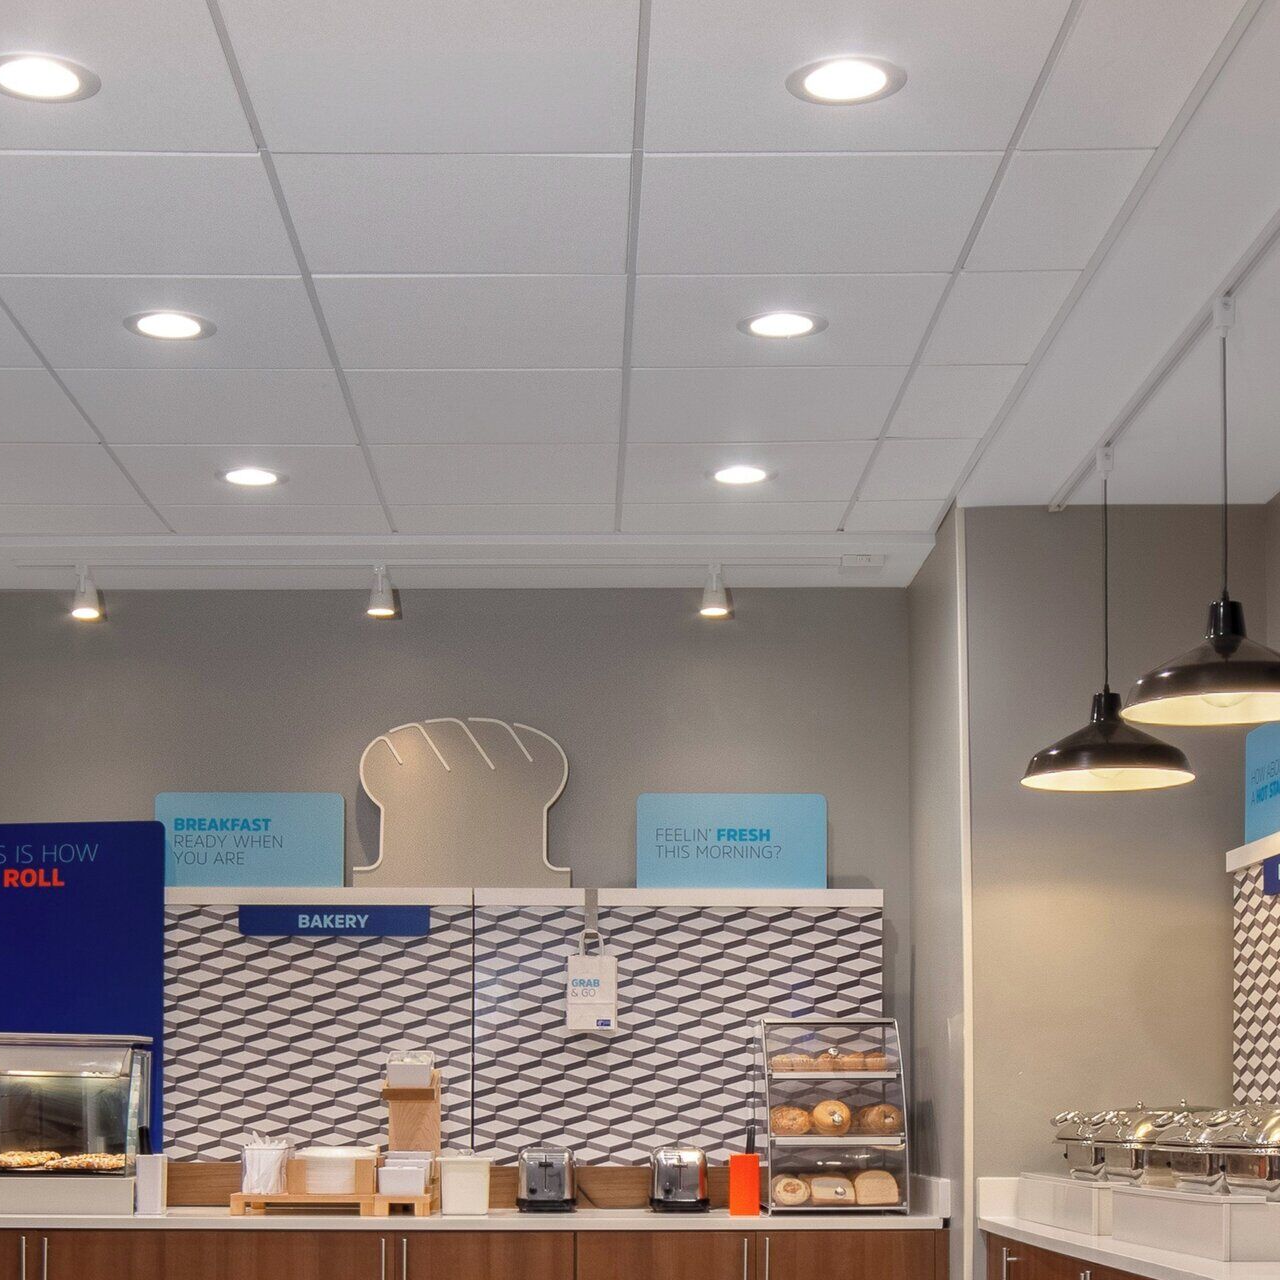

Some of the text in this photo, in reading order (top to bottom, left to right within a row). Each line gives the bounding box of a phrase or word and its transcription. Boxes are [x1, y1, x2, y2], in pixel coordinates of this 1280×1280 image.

[174, 818, 272, 831] BREAKFAST
[174, 834, 284, 848] READY WHEN
[716, 828, 771, 842] FRESH
[15, 844, 34, 864] IS
[42, 843, 99, 863] HOW
[173, 851, 246, 865] YOU ARE
[655, 845, 783, 861] THIS MORNING?
[3, 868, 66, 888] ROLL
[297, 914, 369, 930] BAKERY
[571, 978, 600, 988] GRAB
[570, 988, 596, 998] & GO
